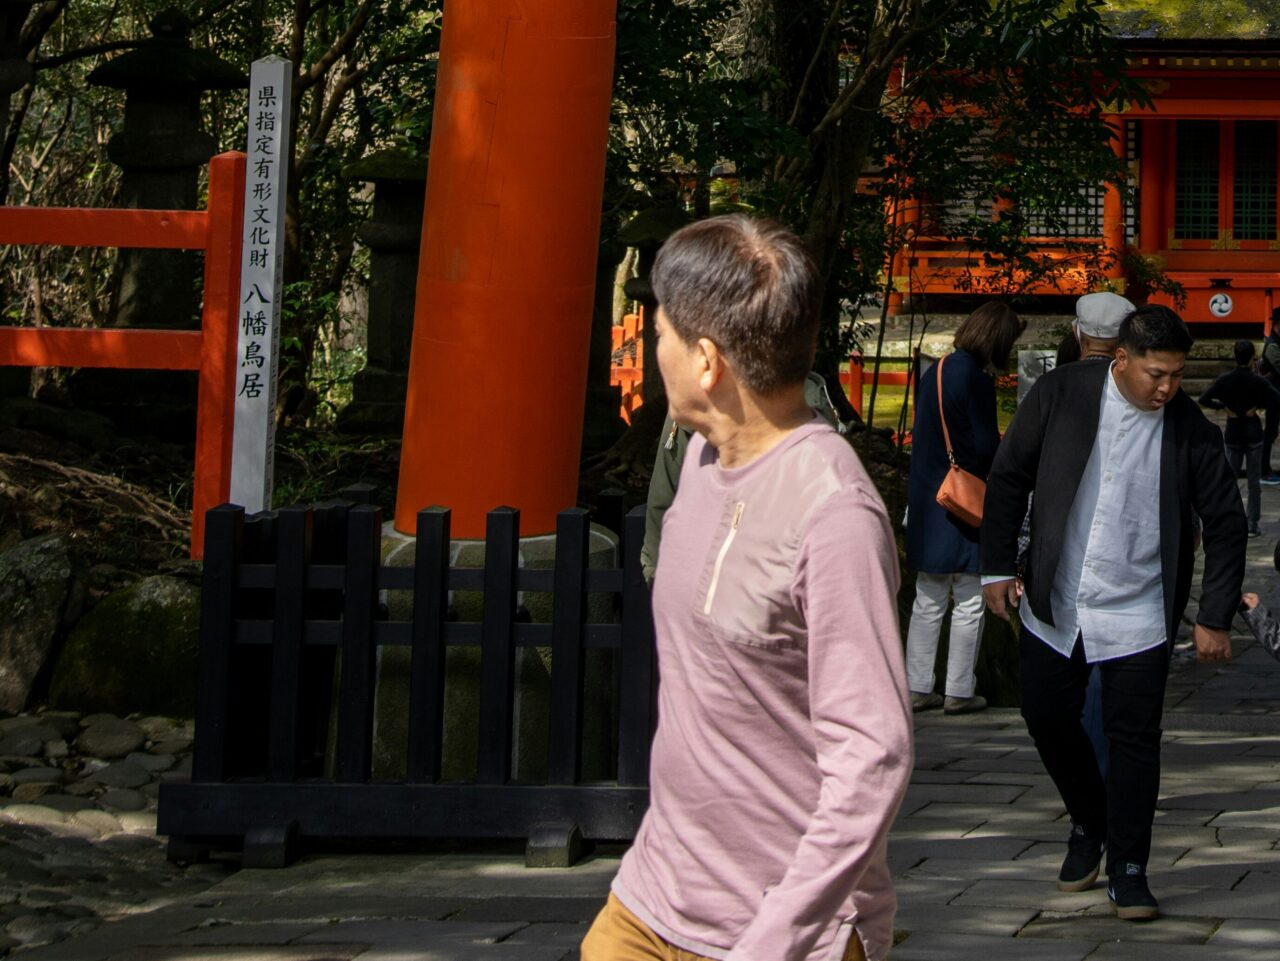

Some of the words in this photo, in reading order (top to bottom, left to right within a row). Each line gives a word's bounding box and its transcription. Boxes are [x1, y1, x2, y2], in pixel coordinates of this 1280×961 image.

[248, 85, 277, 269] 県指定有形文化財
[238, 282, 271, 399] 八幡鳥居
